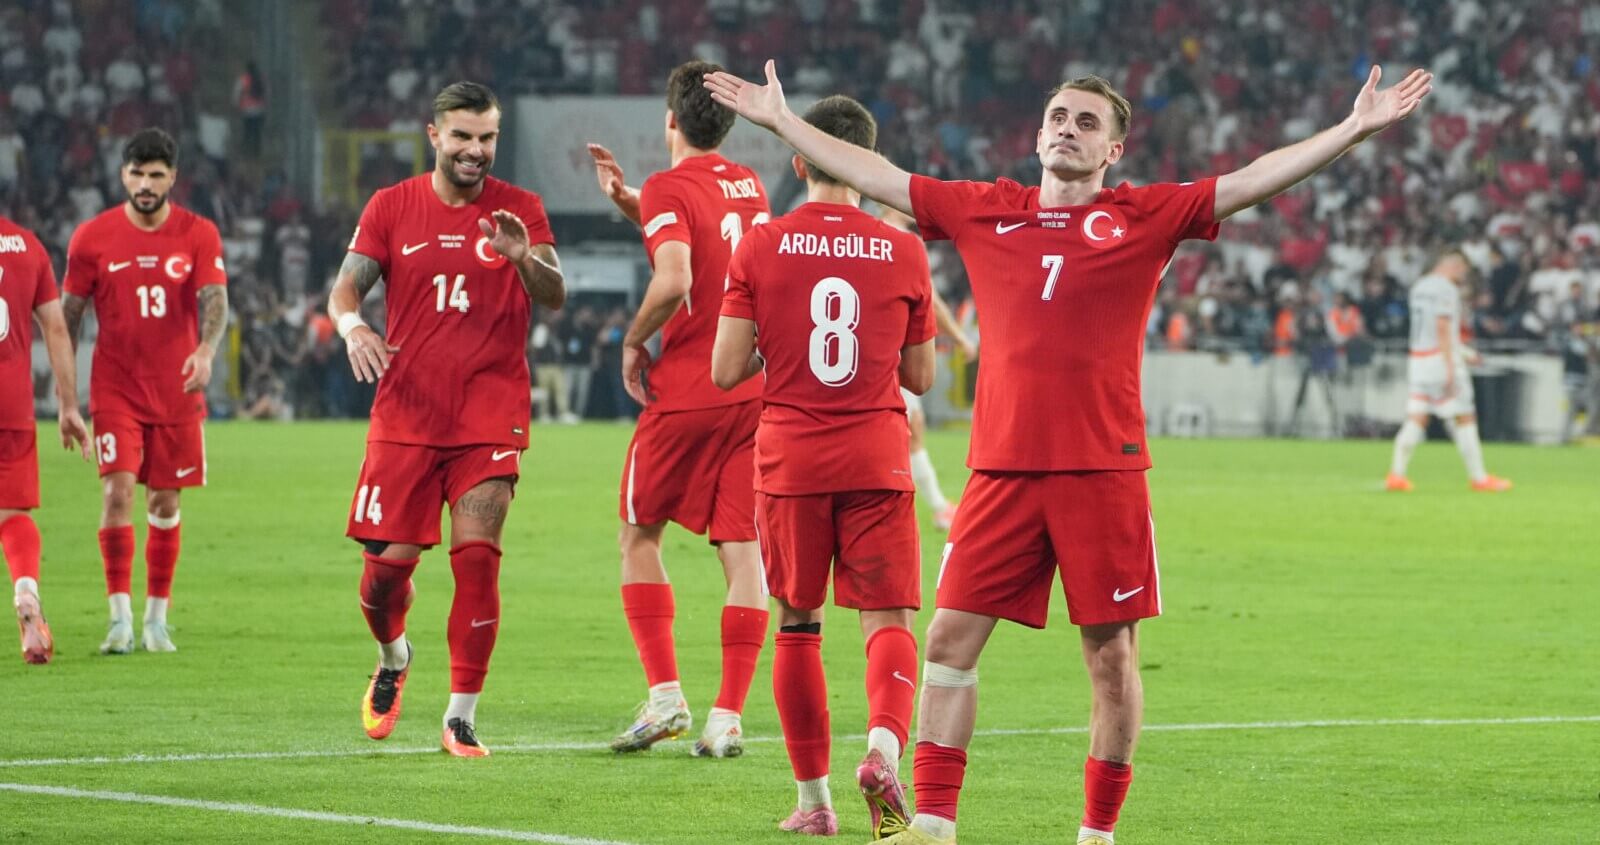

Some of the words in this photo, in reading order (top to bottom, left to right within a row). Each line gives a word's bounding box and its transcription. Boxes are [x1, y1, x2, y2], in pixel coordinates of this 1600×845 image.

[717, 178, 759, 199] YILDIZ
[778, 232, 831, 257] ARDA
[833, 233, 894, 262] GÜLER
[433, 273, 470, 313] 14
[1041, 255, 1064, 301] 7
[136, 285, 167, 318] 13
[808, 276, 860, 387] 8
[95, 432, 117, 466] 13
[354, 484, 383, 525] 14
